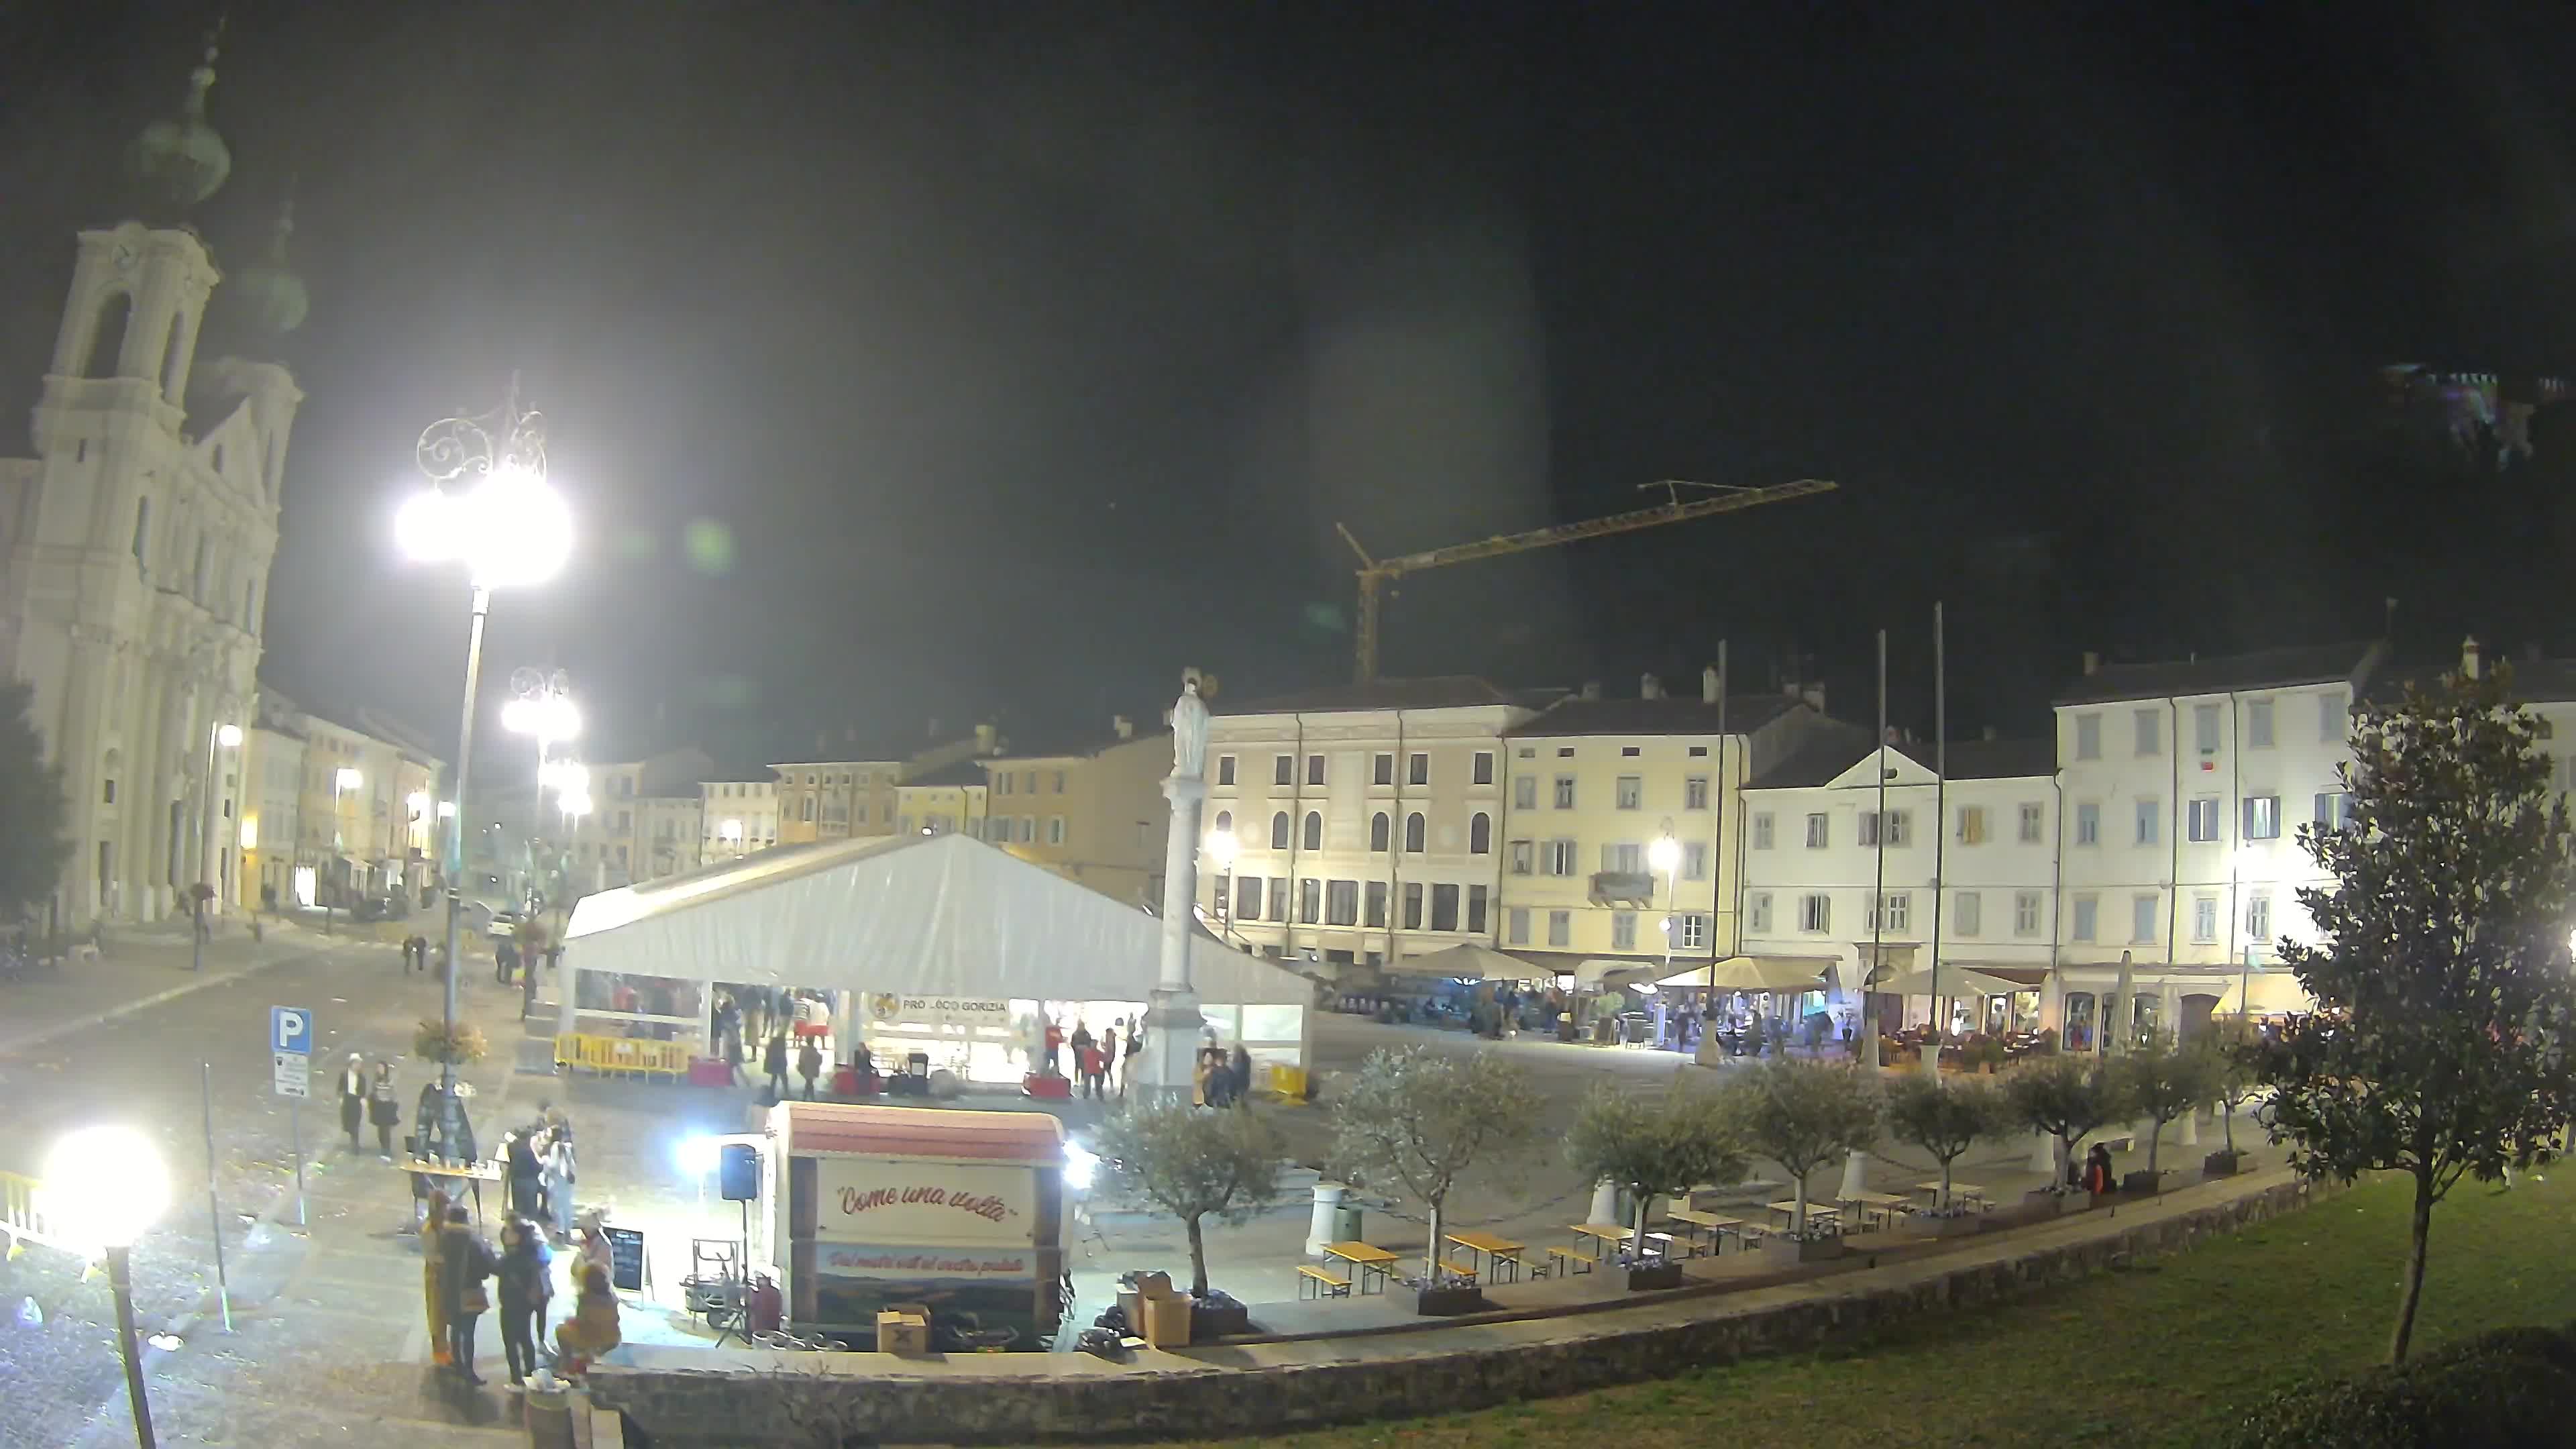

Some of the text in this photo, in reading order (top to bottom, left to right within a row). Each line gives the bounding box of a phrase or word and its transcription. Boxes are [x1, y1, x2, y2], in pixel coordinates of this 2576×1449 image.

[903, 1000, 926, 1010] PRO
[962, 1002, 1006, 1012] GORIZIA
[280, 1011, 304, 1047] P
[902, 1186, 945, 1204] una
